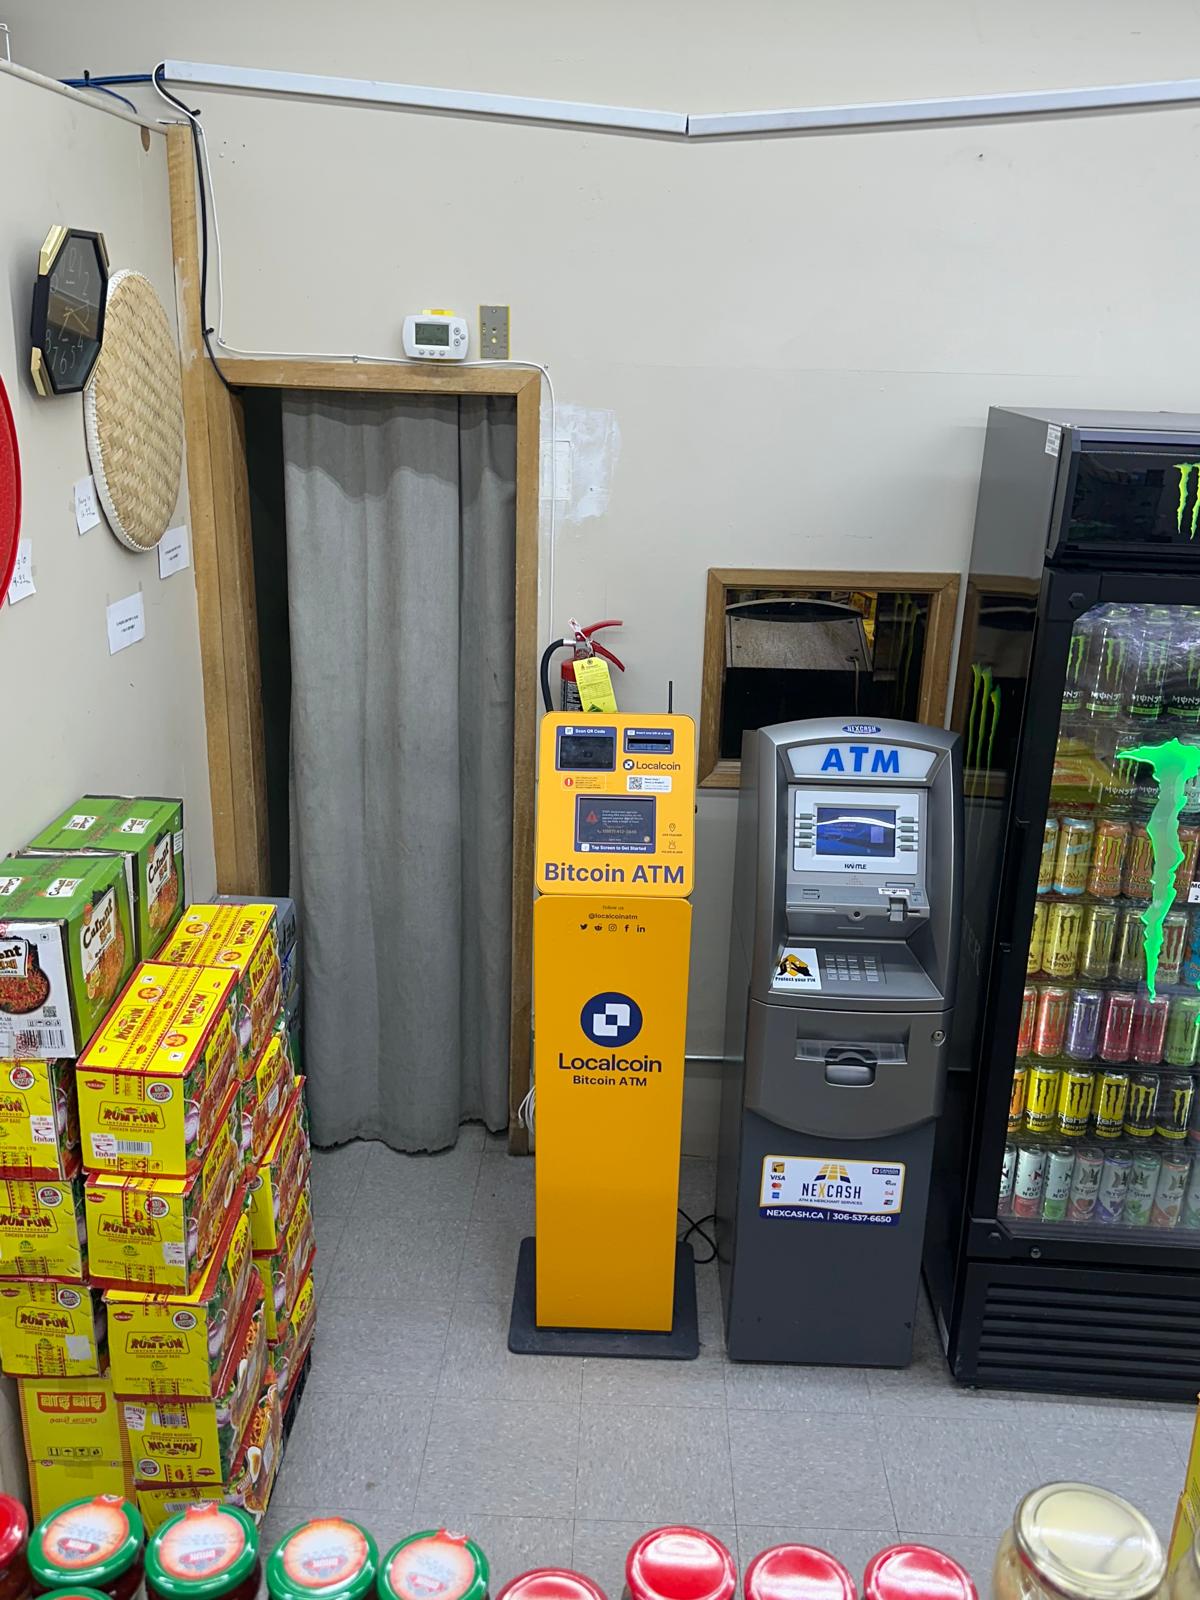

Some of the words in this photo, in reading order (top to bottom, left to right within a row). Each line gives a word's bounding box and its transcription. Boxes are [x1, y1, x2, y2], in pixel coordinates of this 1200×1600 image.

[636, 761, 681, 770] Localcoin
[821, 746, 900, 773] ATM
[545, 862, 625, 883] Bitcoin
[631, 865, 684, 884] ATM
[559, 1053, 662, 1072] Localcoin
[573, 1075, 615, 1086] Bitcoin
[619, 1077, 647, 1087] ATM
[103, 1108, 130, 1121] RUM
[132, 1111, 159, 1124] PUN
[801, 1183, 861, 1200] NEXCASH
[0, 1214, 24, 1227] RUM
[27, 1216, 52, 1228] PUN
[766, 1209, 824, 1219] NEXCASH.CA
[832, 1213, 892, 1223] 306-537-6650
[103, 1221, 128, 1234] RUM
[130, 1226, 156, 1237] PUN
[20, 1312, 43, 1326] RUM
[46, 1317, 69, 1328] PUN
[131, 1338, 156, 1349] RUM
[159, 1338, 184, 1349] PUN
